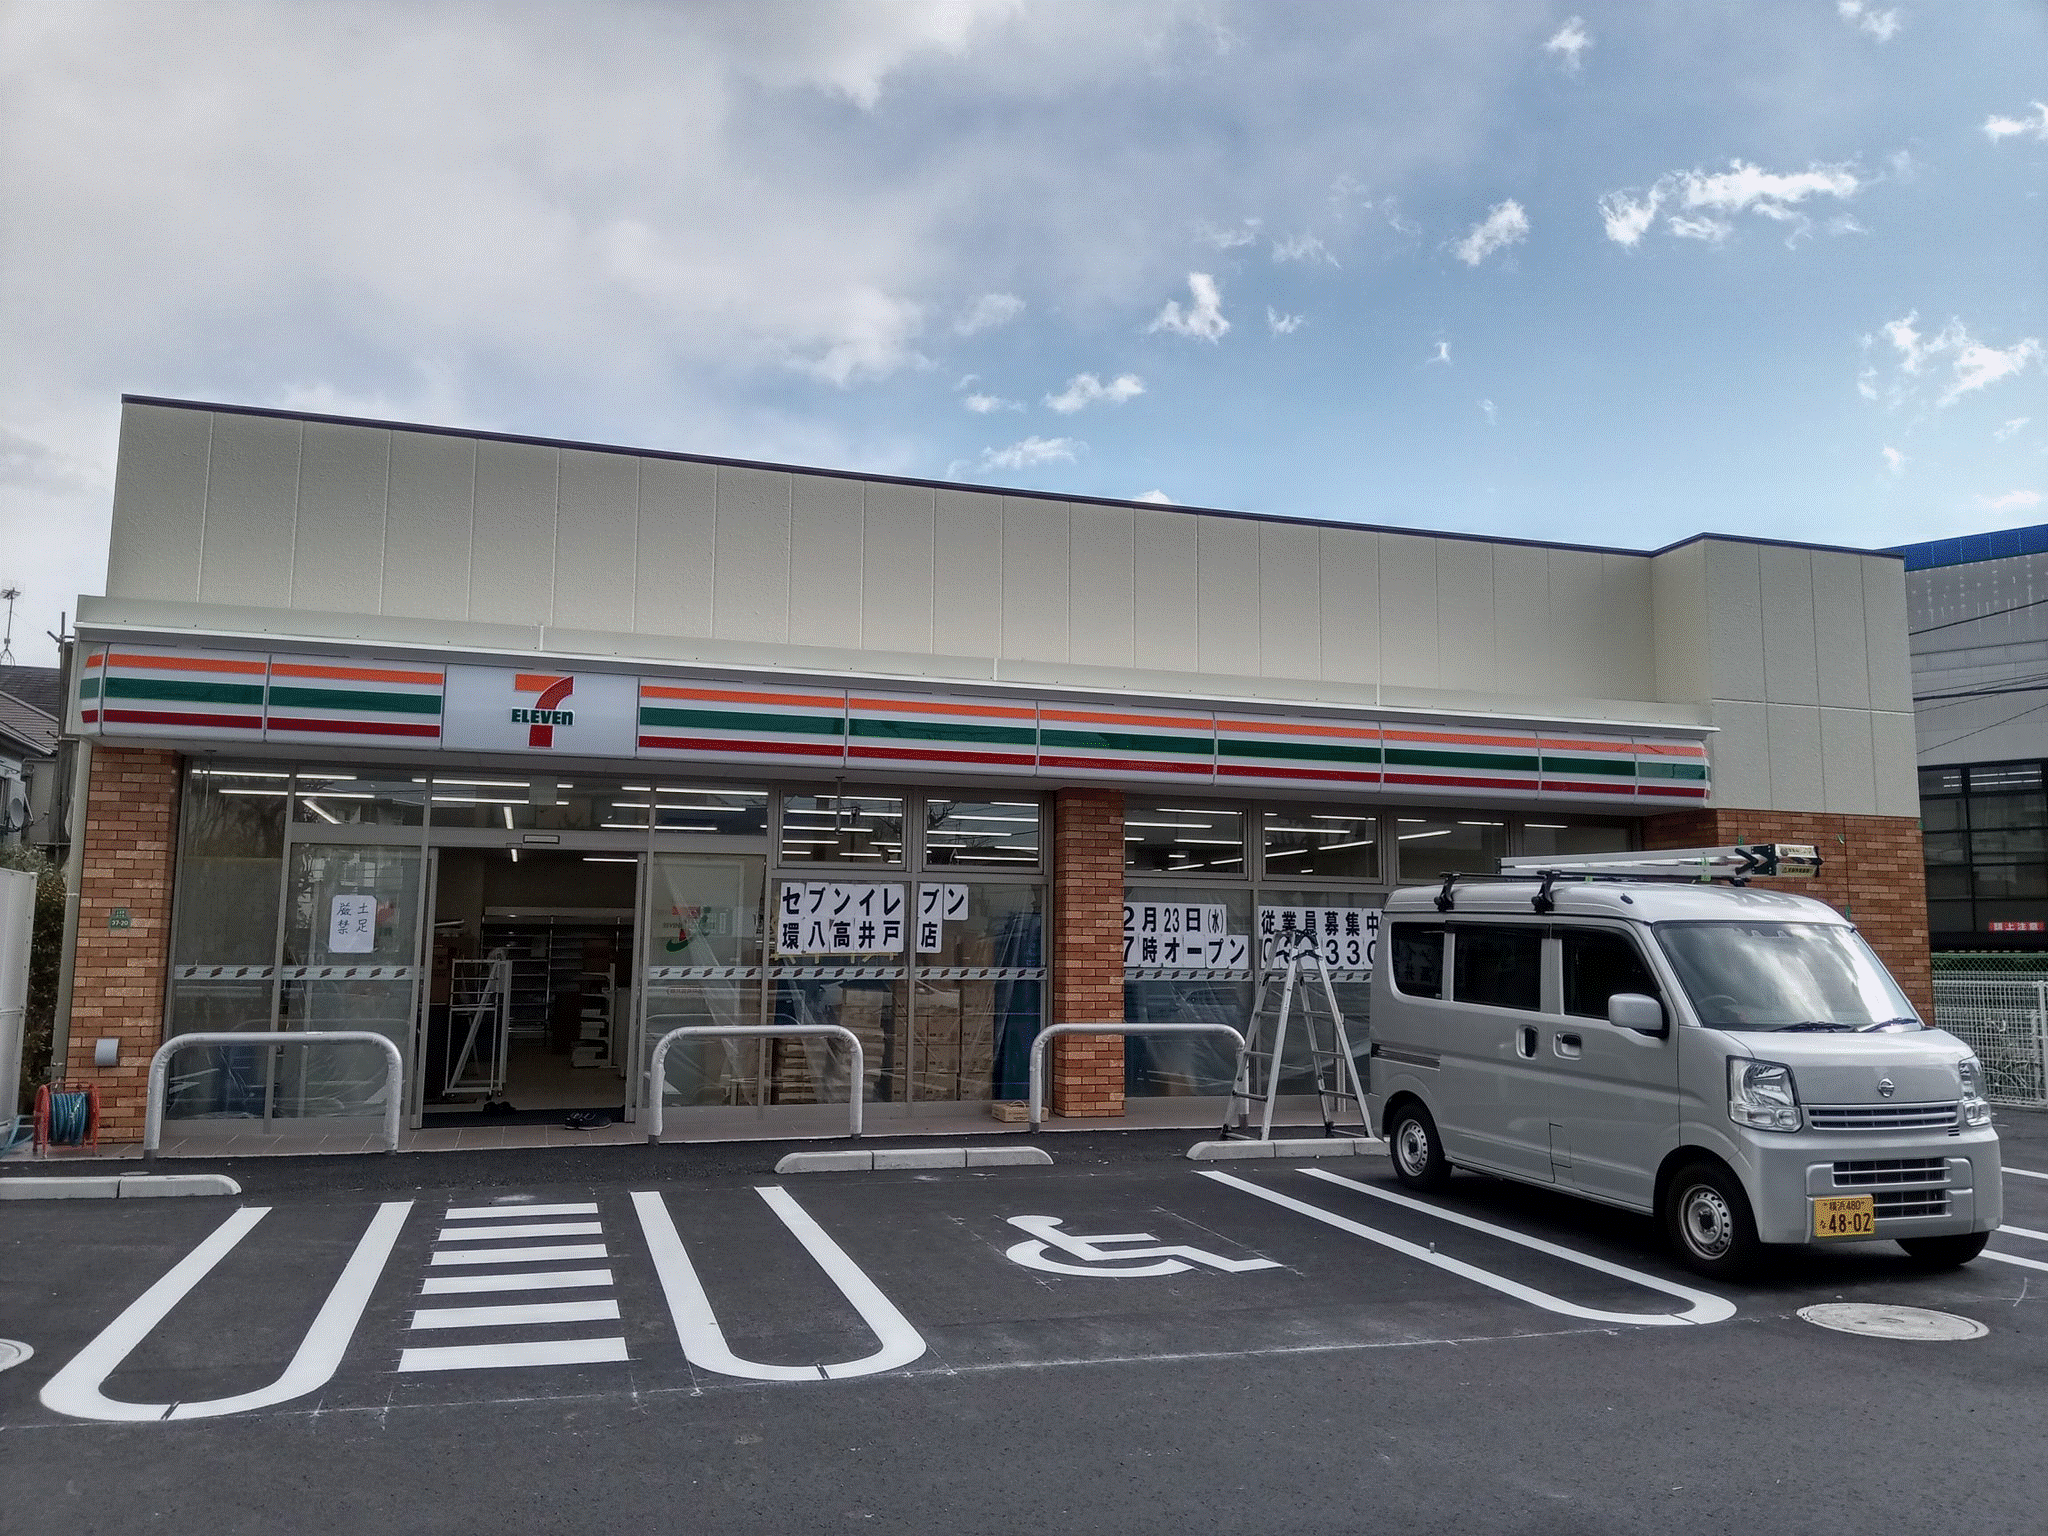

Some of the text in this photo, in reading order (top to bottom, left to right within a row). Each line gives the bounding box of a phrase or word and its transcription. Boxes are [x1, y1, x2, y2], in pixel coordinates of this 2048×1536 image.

[511, 708, 574, 725] ELEVEn
[782, 886, 964, 917] セブンイレブン
[782, 920, 938, 950] 環八高井戸店
[1261, 909, 1379, 937] 従業員募集中
[1123, 936, 1245, 965] 7時オープン
[1829, 1213, 1871, 1233] 48-02
